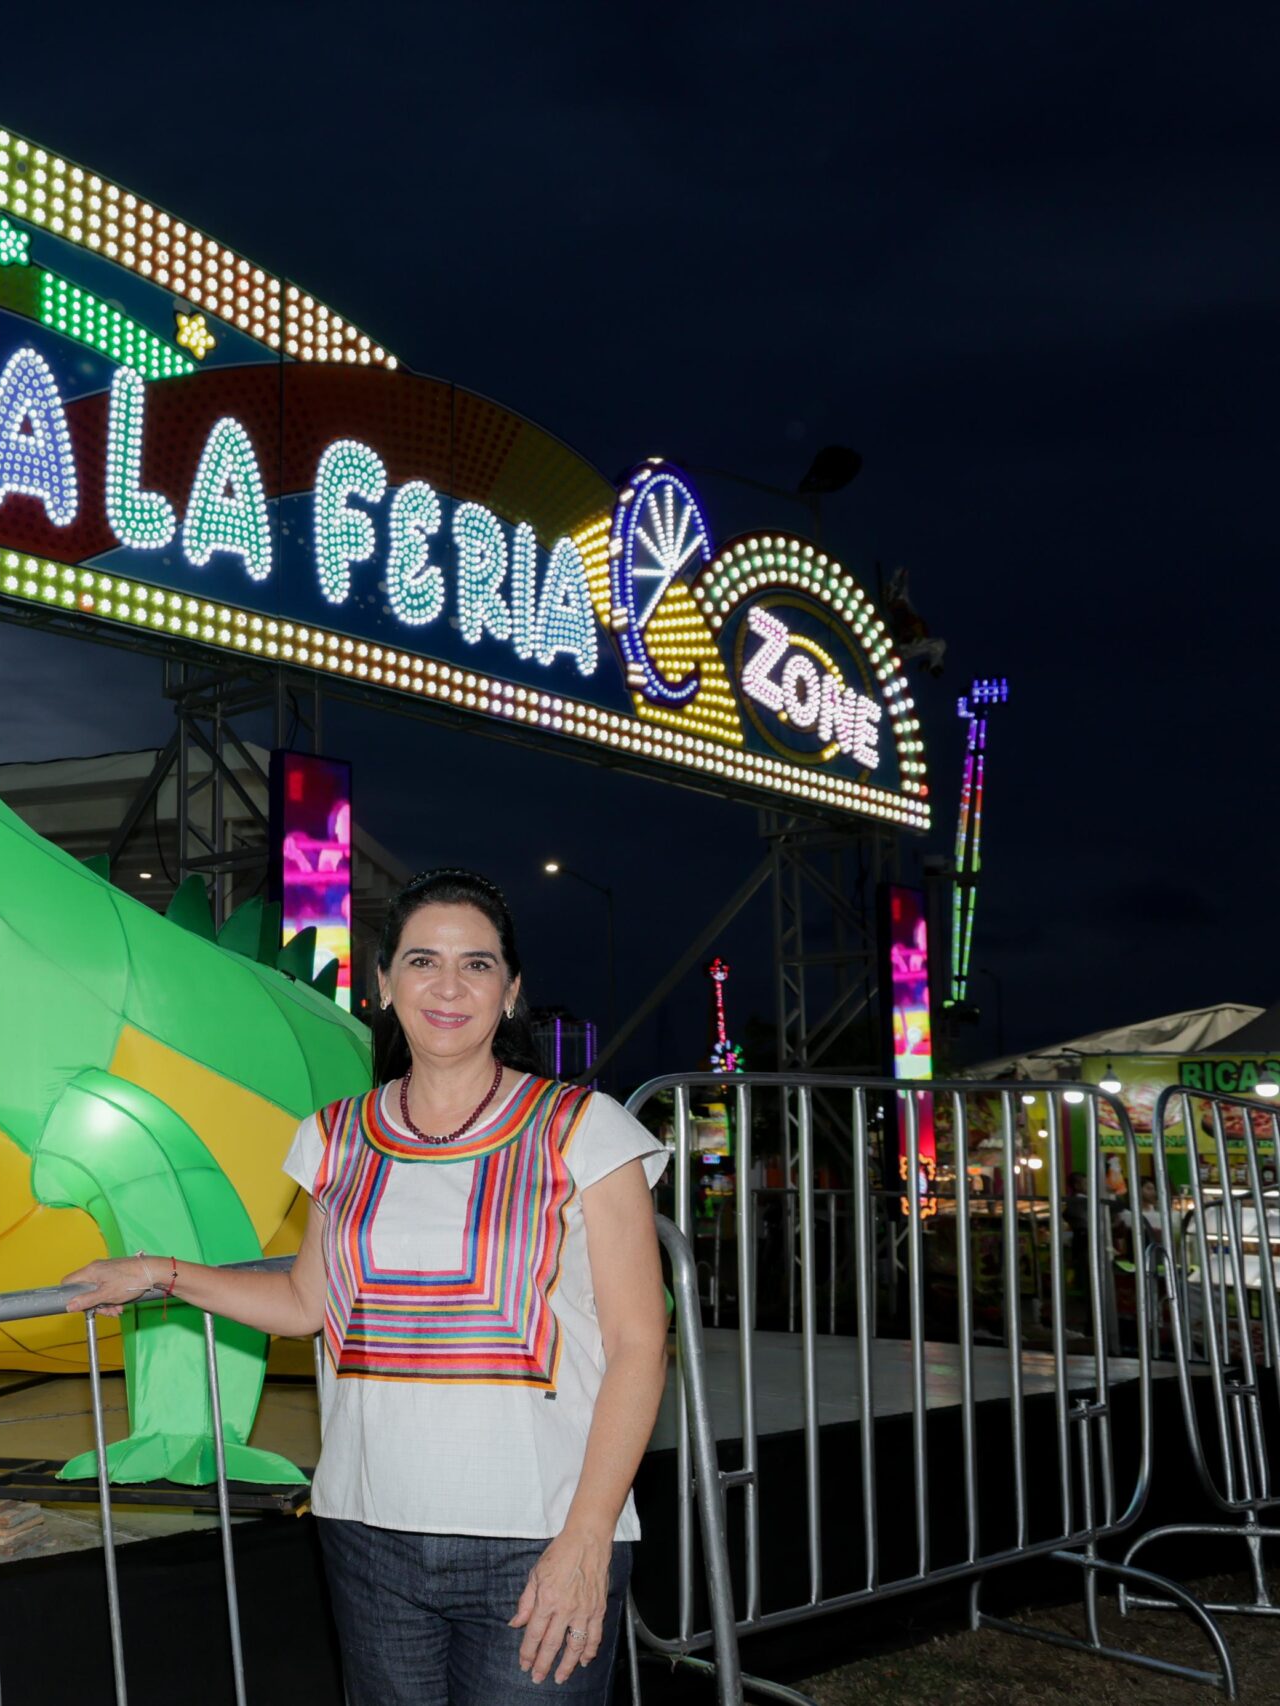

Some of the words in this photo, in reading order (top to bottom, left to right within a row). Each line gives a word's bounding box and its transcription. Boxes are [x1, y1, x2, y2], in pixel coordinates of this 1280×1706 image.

[104, 364, 273, 582] LA
[314, 437, 599, 677] FERIA
[741, 605, 883, 770] ZONE
